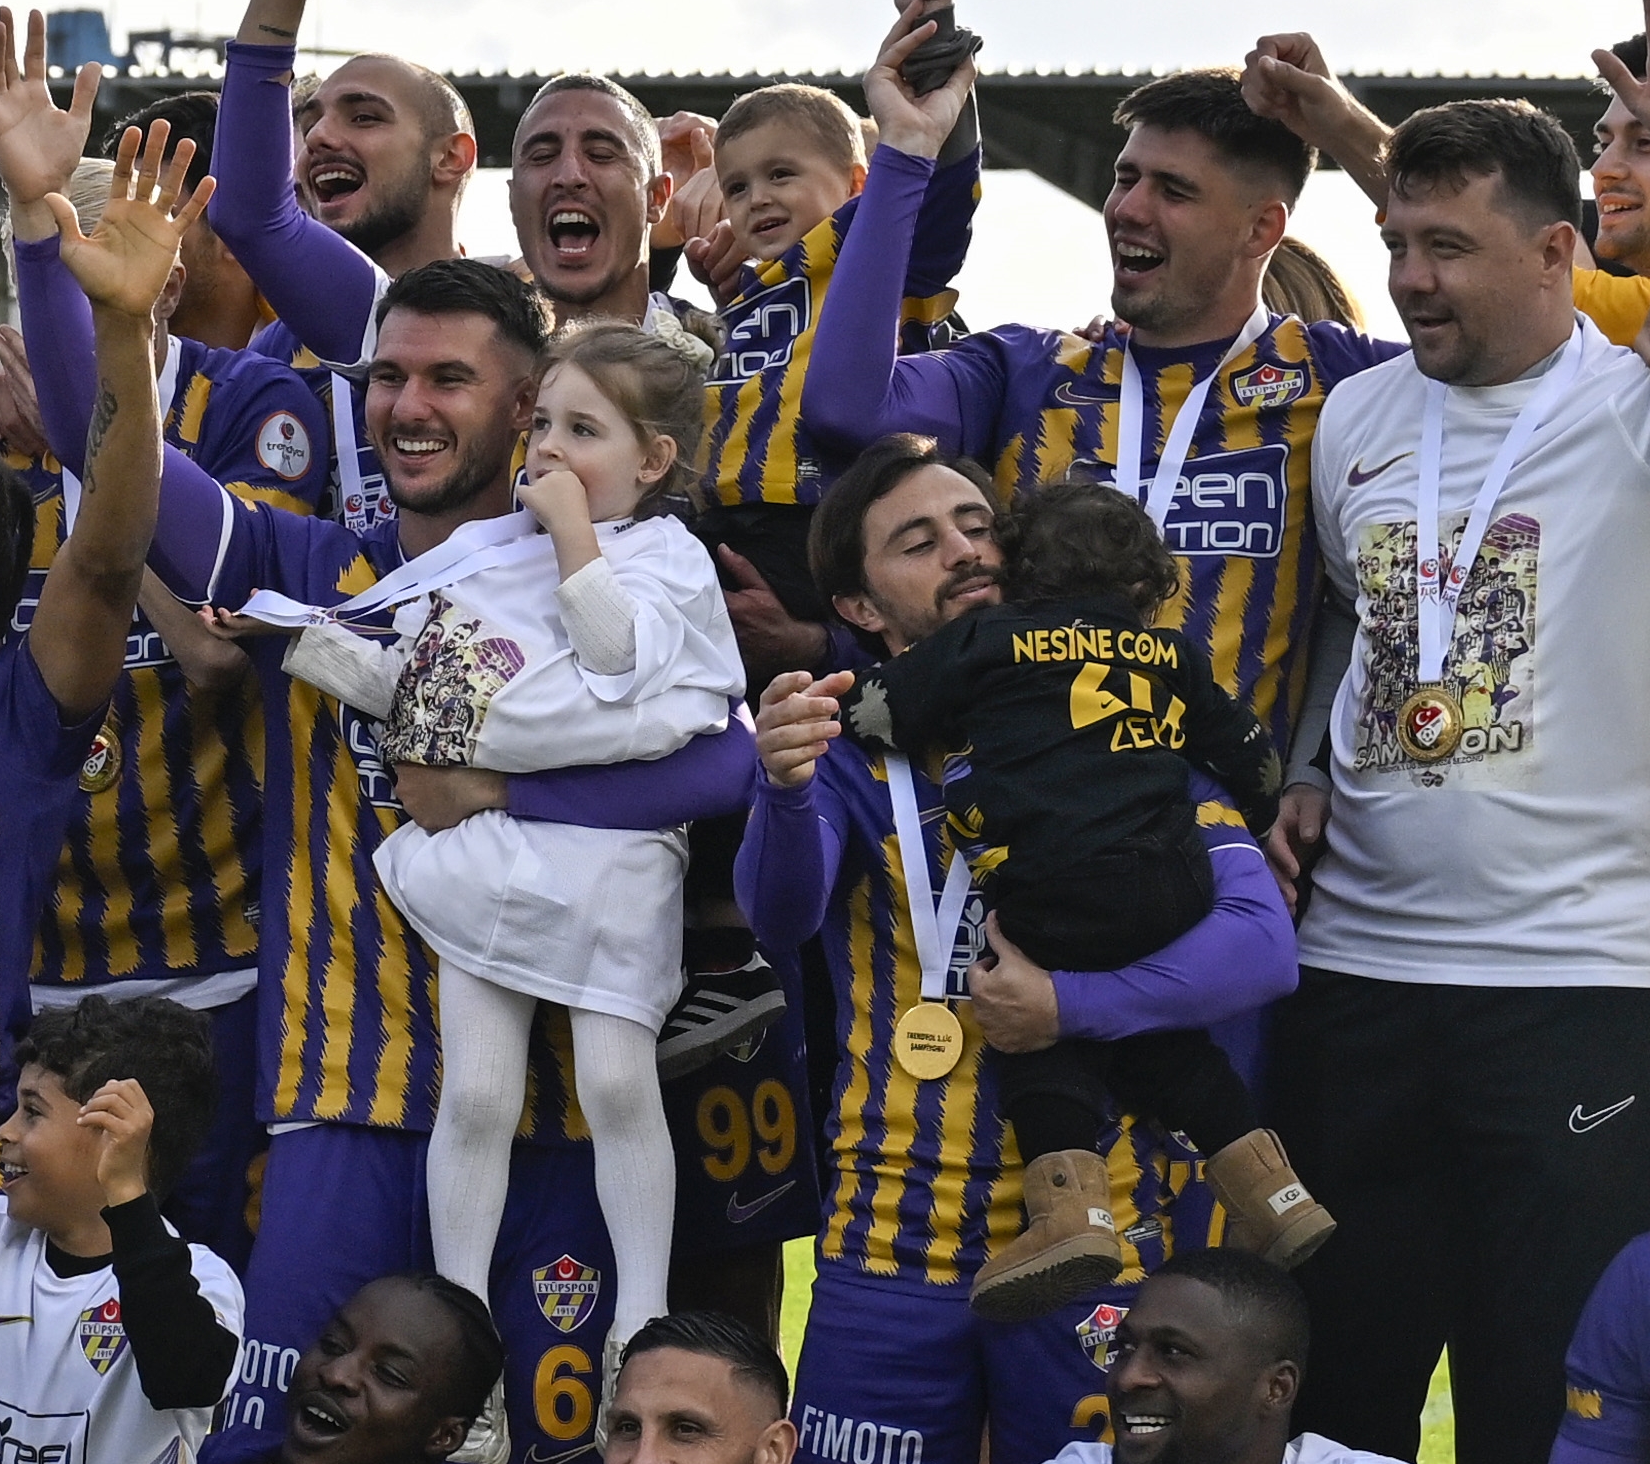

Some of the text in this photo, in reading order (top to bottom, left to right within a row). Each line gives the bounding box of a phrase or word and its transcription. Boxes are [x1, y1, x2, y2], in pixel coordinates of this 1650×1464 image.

[699, 1078, 797, 1181] 99
[1279, 1188, 1301, 1204] UGG
[537, 1281, 596, 1294] EYÜPSPOR
[533, 1345, 593, 1440] 6
